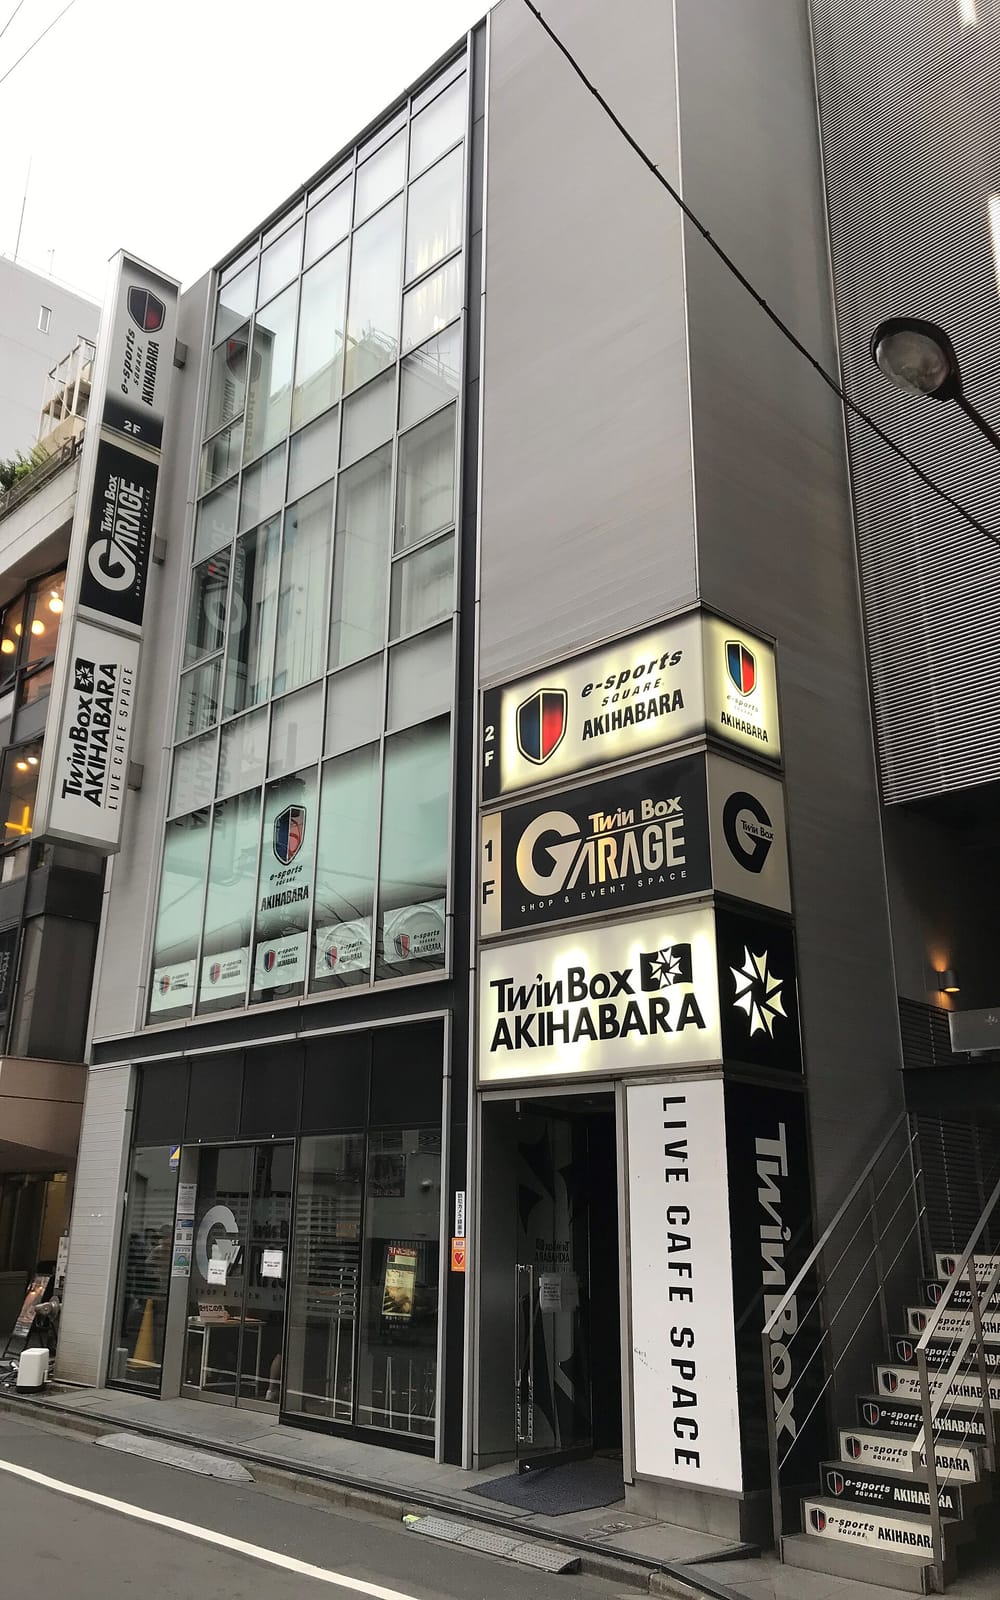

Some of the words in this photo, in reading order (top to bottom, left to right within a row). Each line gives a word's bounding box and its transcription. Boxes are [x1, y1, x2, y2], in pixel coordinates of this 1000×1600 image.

[120, 328, 136, 395] e-sports
[141, 340, 160, 407] AKIHABARA
[123, 420, 141, 434] 2F
[104, 474, 118, 501] Box
[100, 502, 114, 532] Twin
[88, 478, 144, 591] GARAGE
[581, 650, 683, 698] e-sports
[119, 667, 133, 717] SPACE
[601, 678, 662, 707] SQUARE
[726, 695, 759, 713] e-sports
[582, 688, 684, 742] AKIHABARA
[720, 711, 769, 743] AKIHABARA
[83, 664, 118, 808] AKIHABARA
[113, 725, 127, 765] CAFE
[108, 774, 121, 810] LIVE
[588, 808, 635, 834] Twin
[641, 796, 683, 820] Box
[740, 819, 759, 835] Twin
[760, 827, 774, 840] Box
[516, 811, 686, 897] GARAGE
[270, 865, 303, 880] e-sports
[260, 885, 309, 911] AKIHABARA
[520, 899, 554, 913] SHOP
[581, 883, 626, 901] EVENT
[637, 870, 687, 888] SPACE
[489, 993, 706, 1052] AKIHABARA
[662, 1096, 689, 1184] LIVE
[666, 1205, 694, 1304] CAFE
[669, 1326, 701, 1470] SPACE
[880, 1410, 924, 1422] e-sports
[863, 1443, 908, 1458] e-sports
[872, 1454, 900, 1464] SQUARE
[844, 1478, 891, 1494] e-sports
[854, 1490, 882, 1500] SQUARE
[893, 1487, 954, 1510] AKIHABRA
[828, 1515, 875, 1532] e-sports
[838, 1528, 866, 1538] SQUARE
[877, 1526, 933, 1550] AKIHABAR
